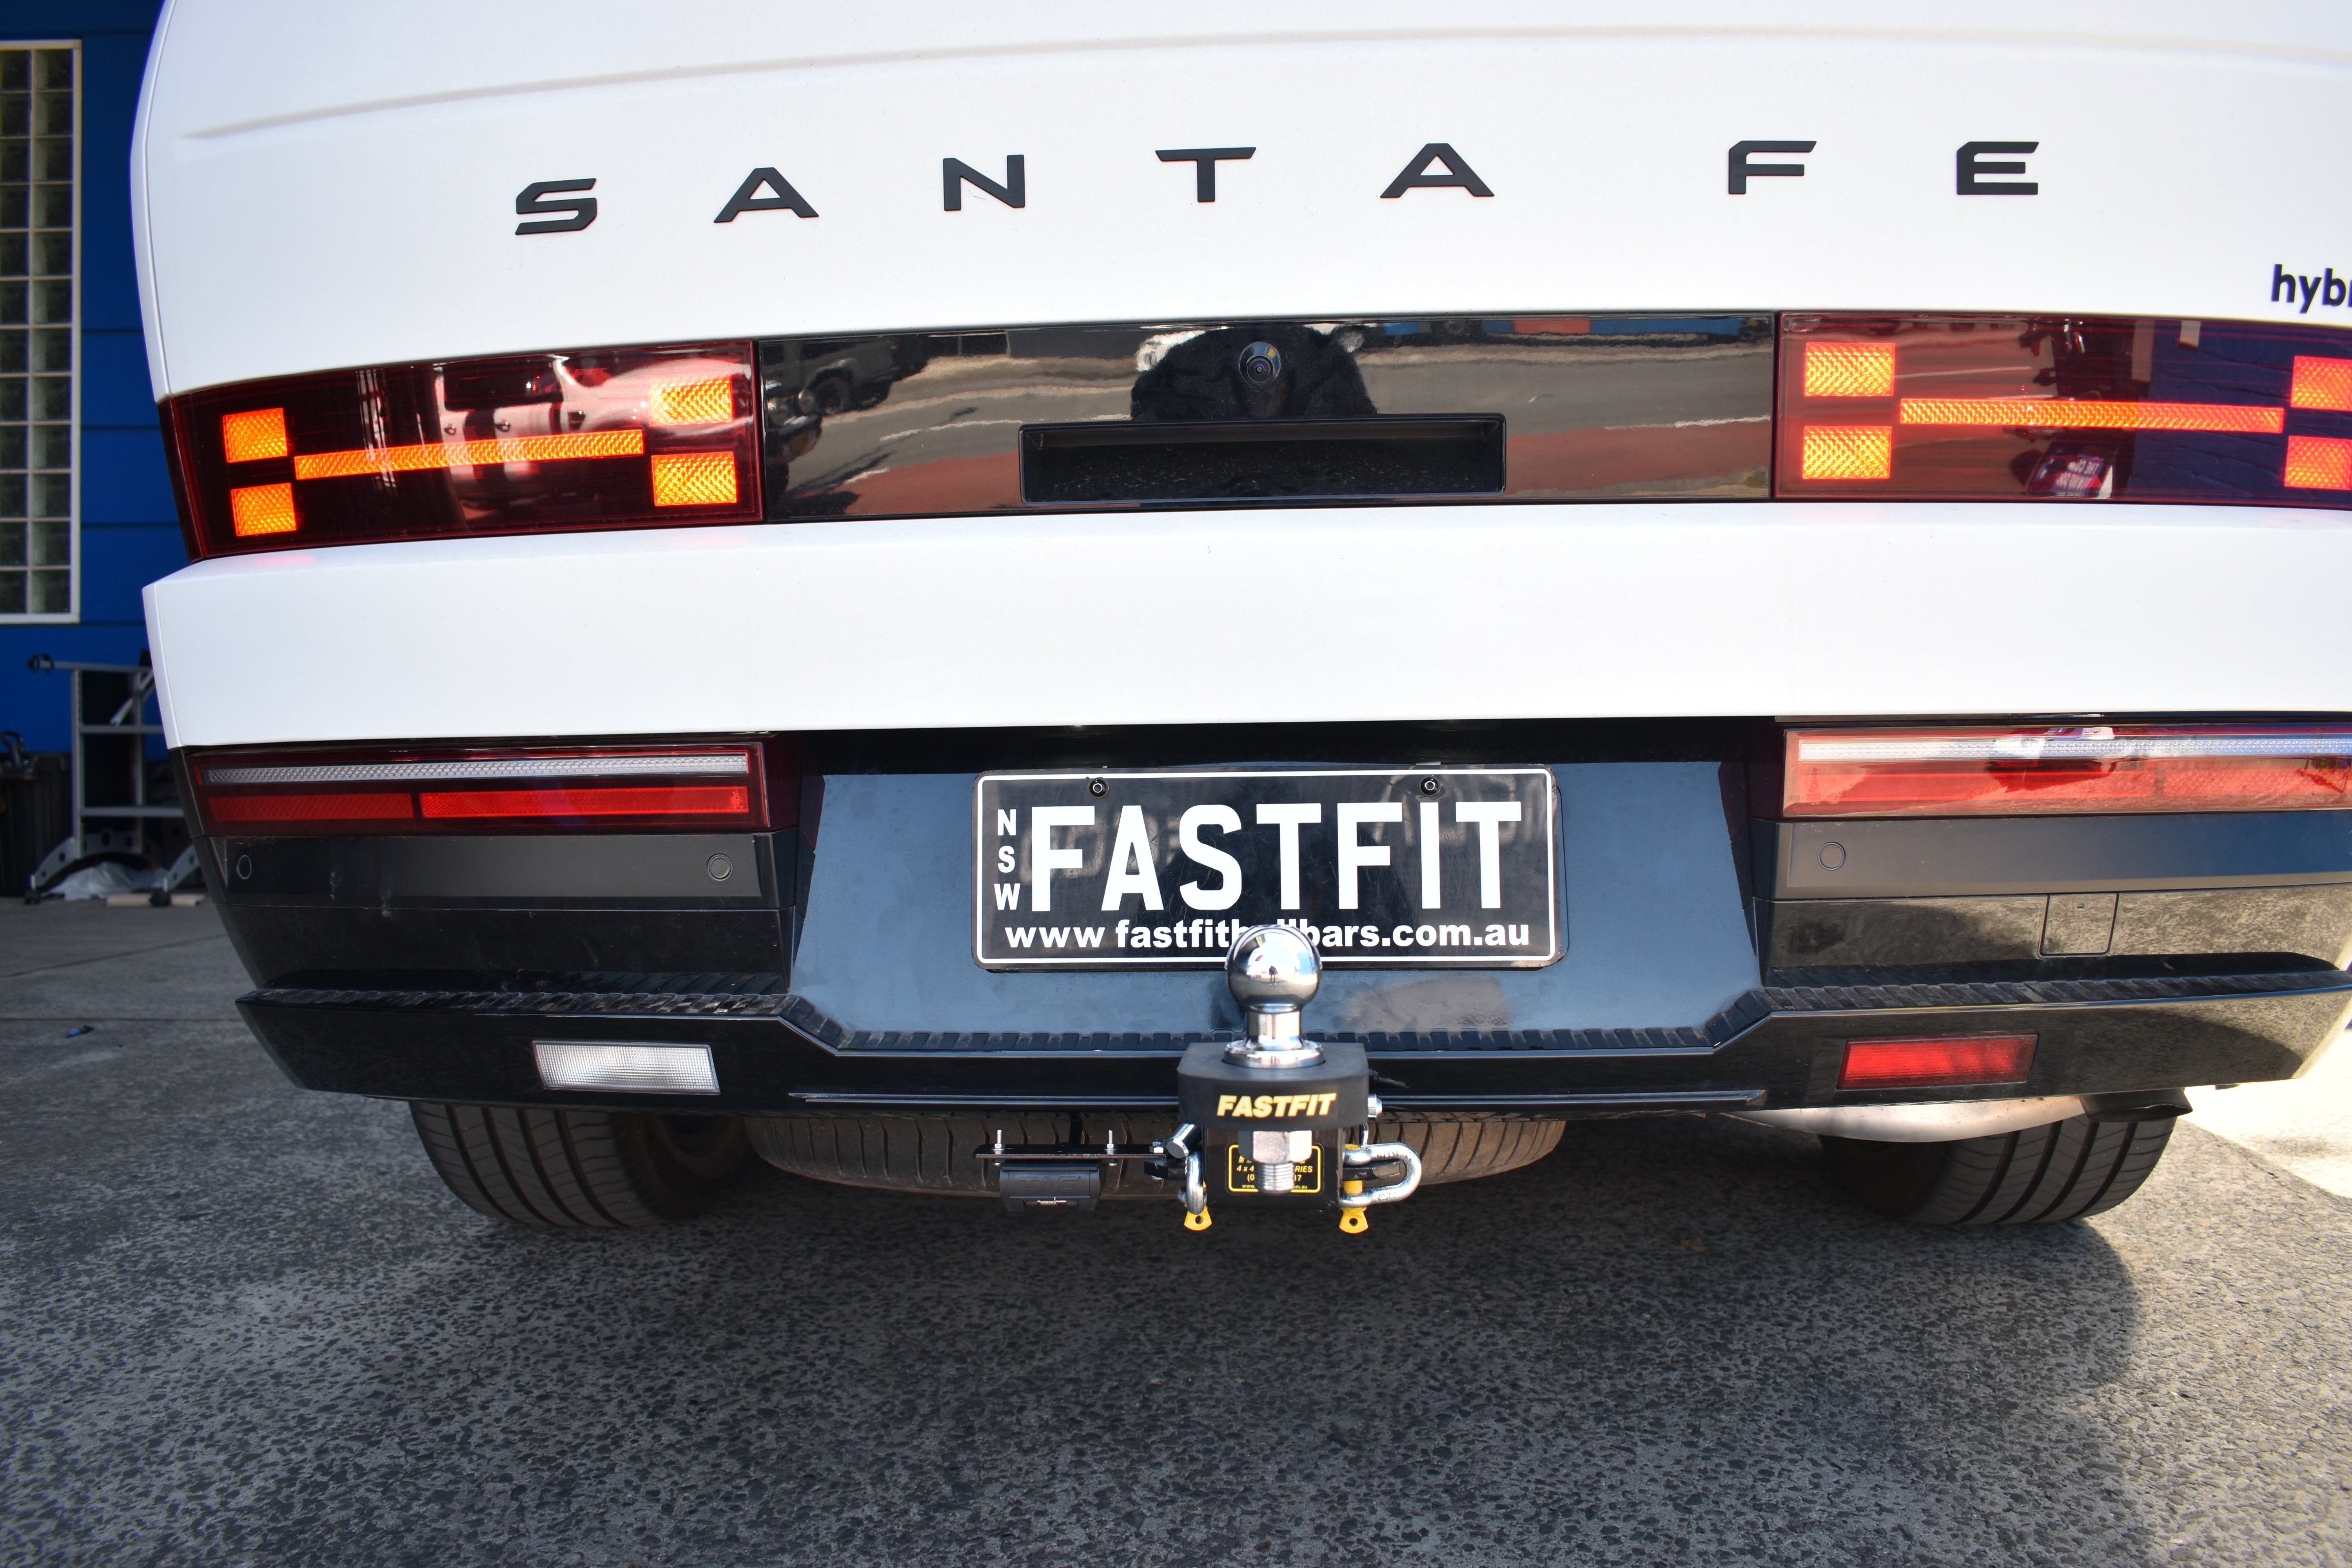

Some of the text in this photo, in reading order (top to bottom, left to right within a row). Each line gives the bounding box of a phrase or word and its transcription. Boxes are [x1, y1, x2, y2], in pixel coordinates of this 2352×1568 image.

[515, 140, 2040, 236] SANTA FE
[2271, 263, 2352, 314] hyb
[1031, 801, 1522, 912] FASTFIT
[1005, 927, 1105, 948] www
[1217, 1093, 1337, 1118] FASTFIT
